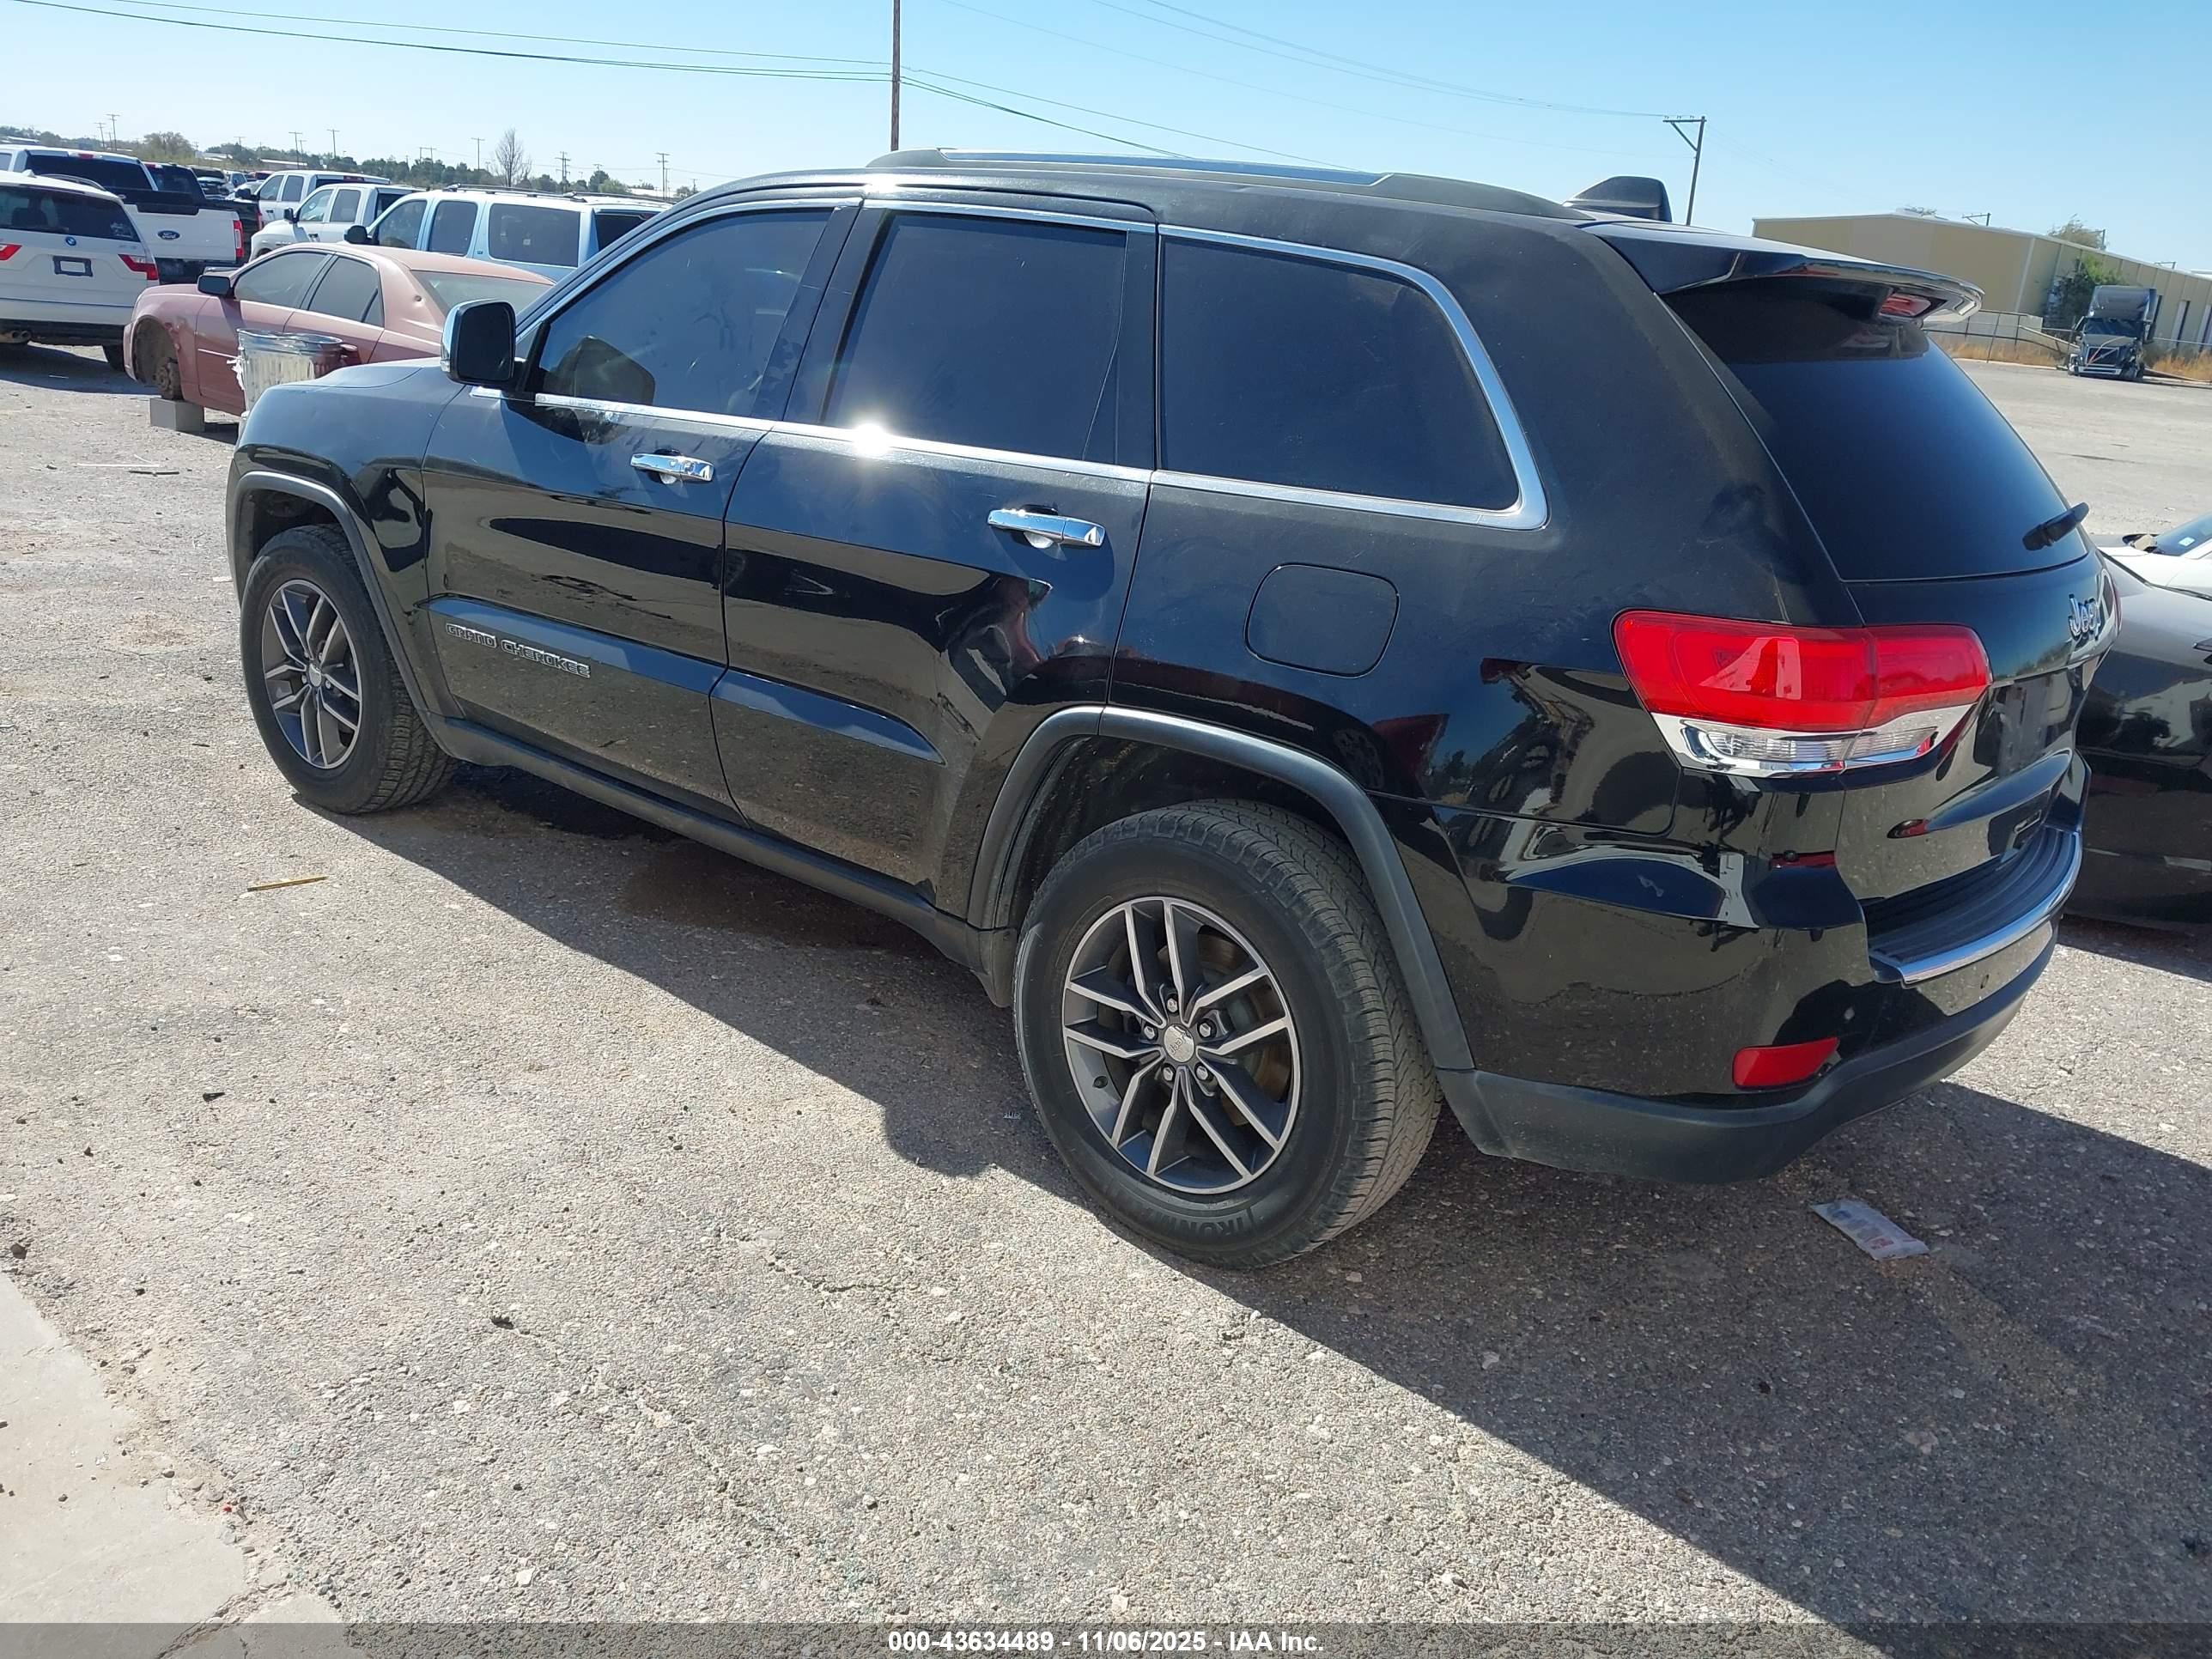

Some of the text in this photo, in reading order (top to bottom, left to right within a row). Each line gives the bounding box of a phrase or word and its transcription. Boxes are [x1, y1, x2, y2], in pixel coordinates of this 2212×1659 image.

[2068, 593, 2101, 641] Jeep
[446, 623, 591, 678] GRAND CHEROKEE
